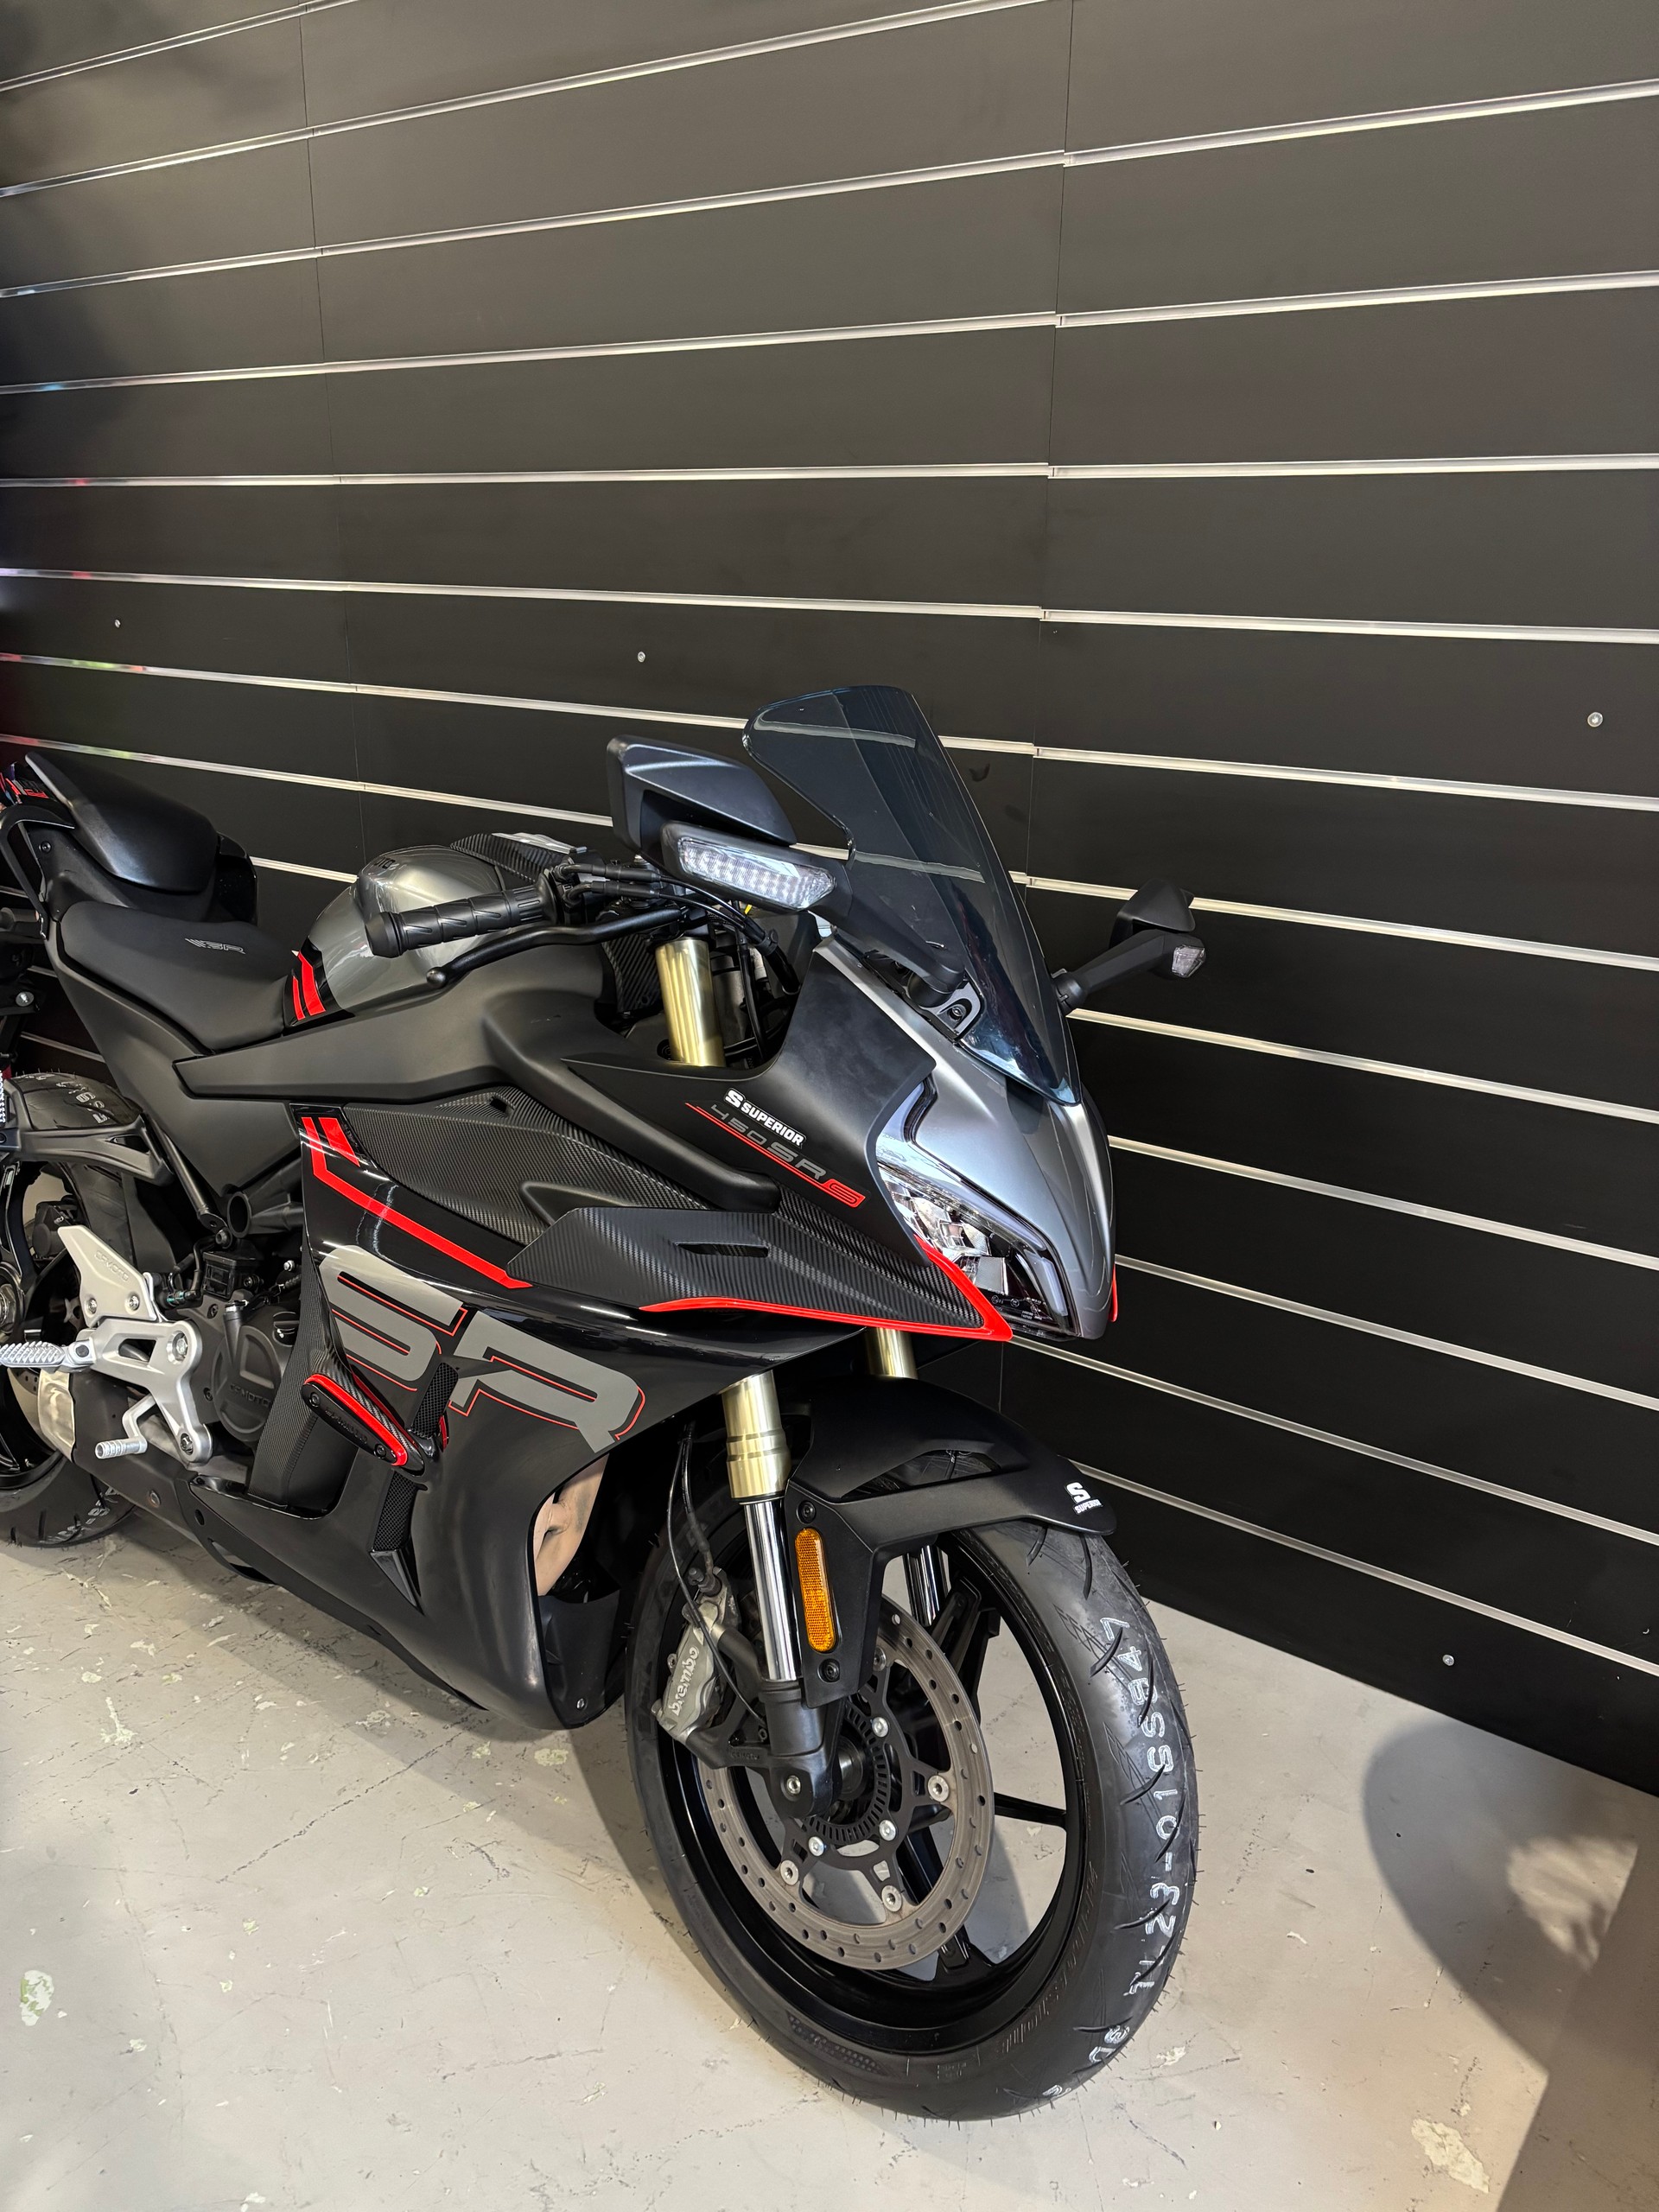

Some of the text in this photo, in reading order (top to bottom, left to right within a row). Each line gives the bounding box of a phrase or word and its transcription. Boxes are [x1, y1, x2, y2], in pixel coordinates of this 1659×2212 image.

[741, 1103, 805, 1147] SUPERIOR
[319, 1244, 645, 1453] SR
[668, 1646, 700, 1716] brembo
